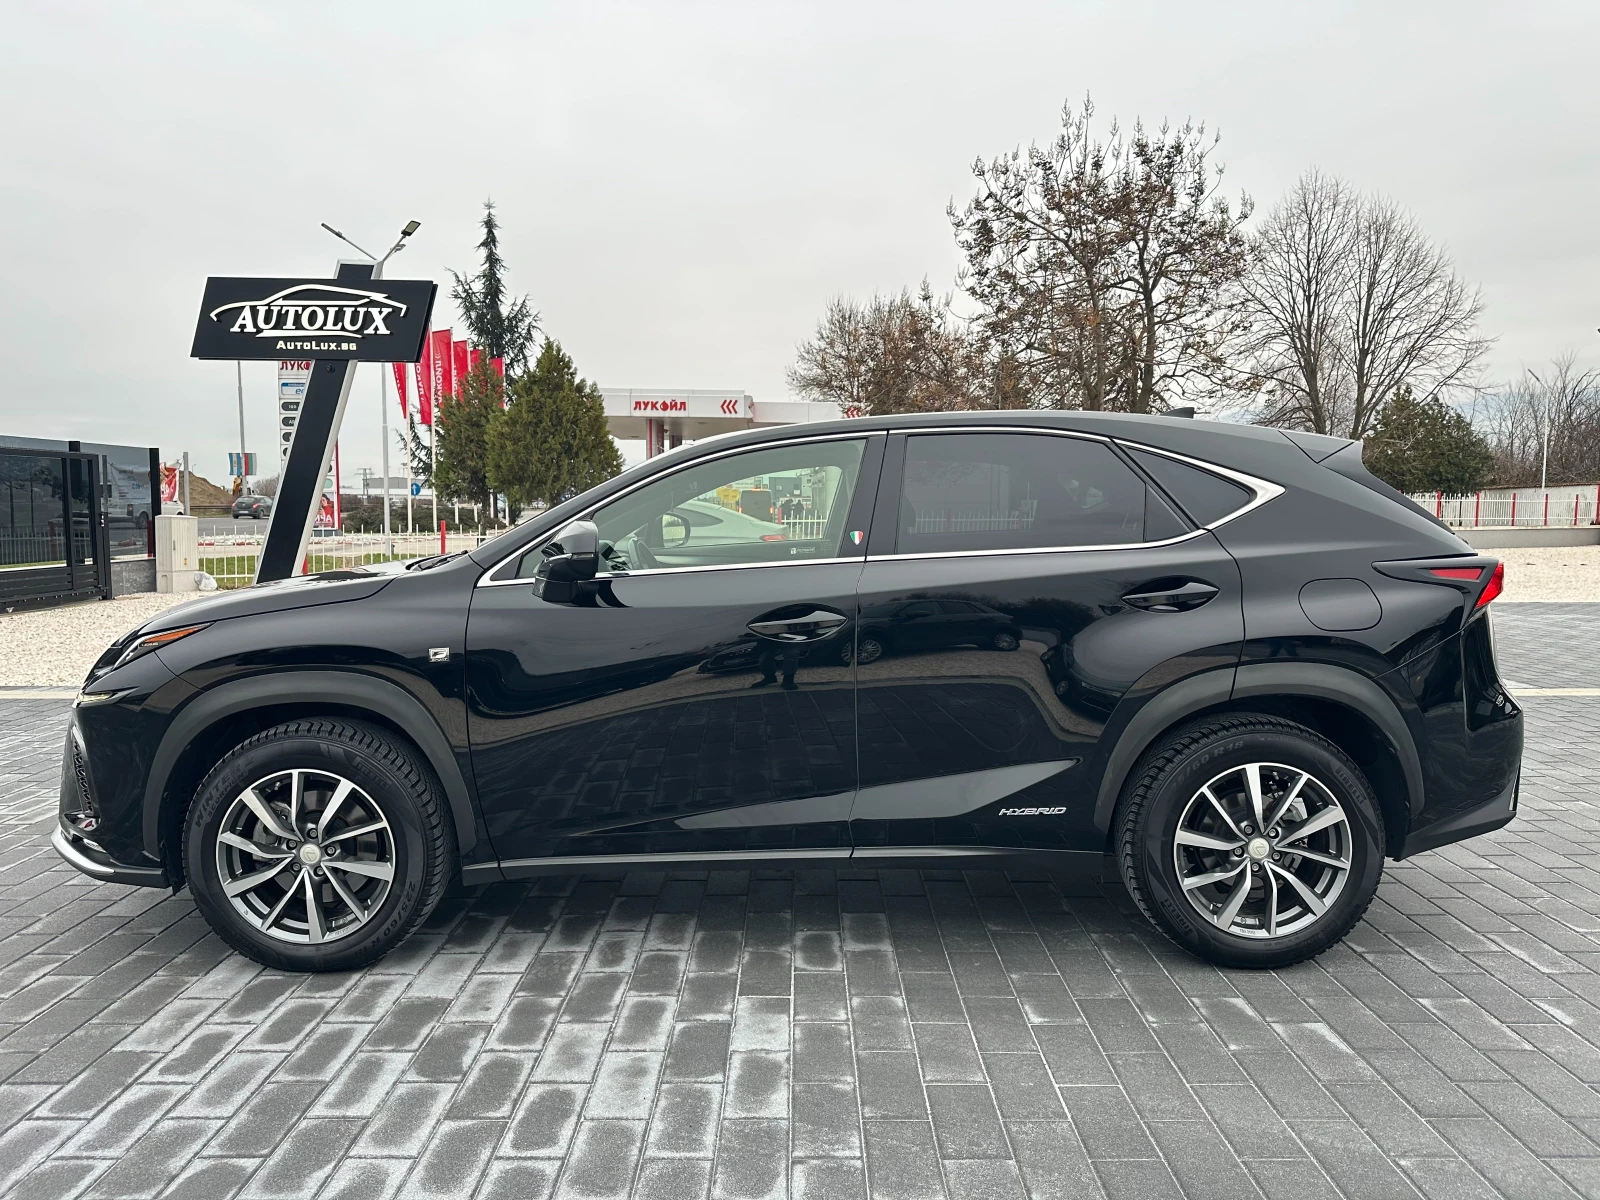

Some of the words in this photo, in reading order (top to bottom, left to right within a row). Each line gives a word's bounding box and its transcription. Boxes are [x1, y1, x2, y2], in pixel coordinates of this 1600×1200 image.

[230, 305, 393, 335] AUTOLUX
[280, 361, 311, 371] ЛУКО
[633, 398, 685, 411] ЛУКОЙЛ
[998, 807, 1067, 816] HYBRID
